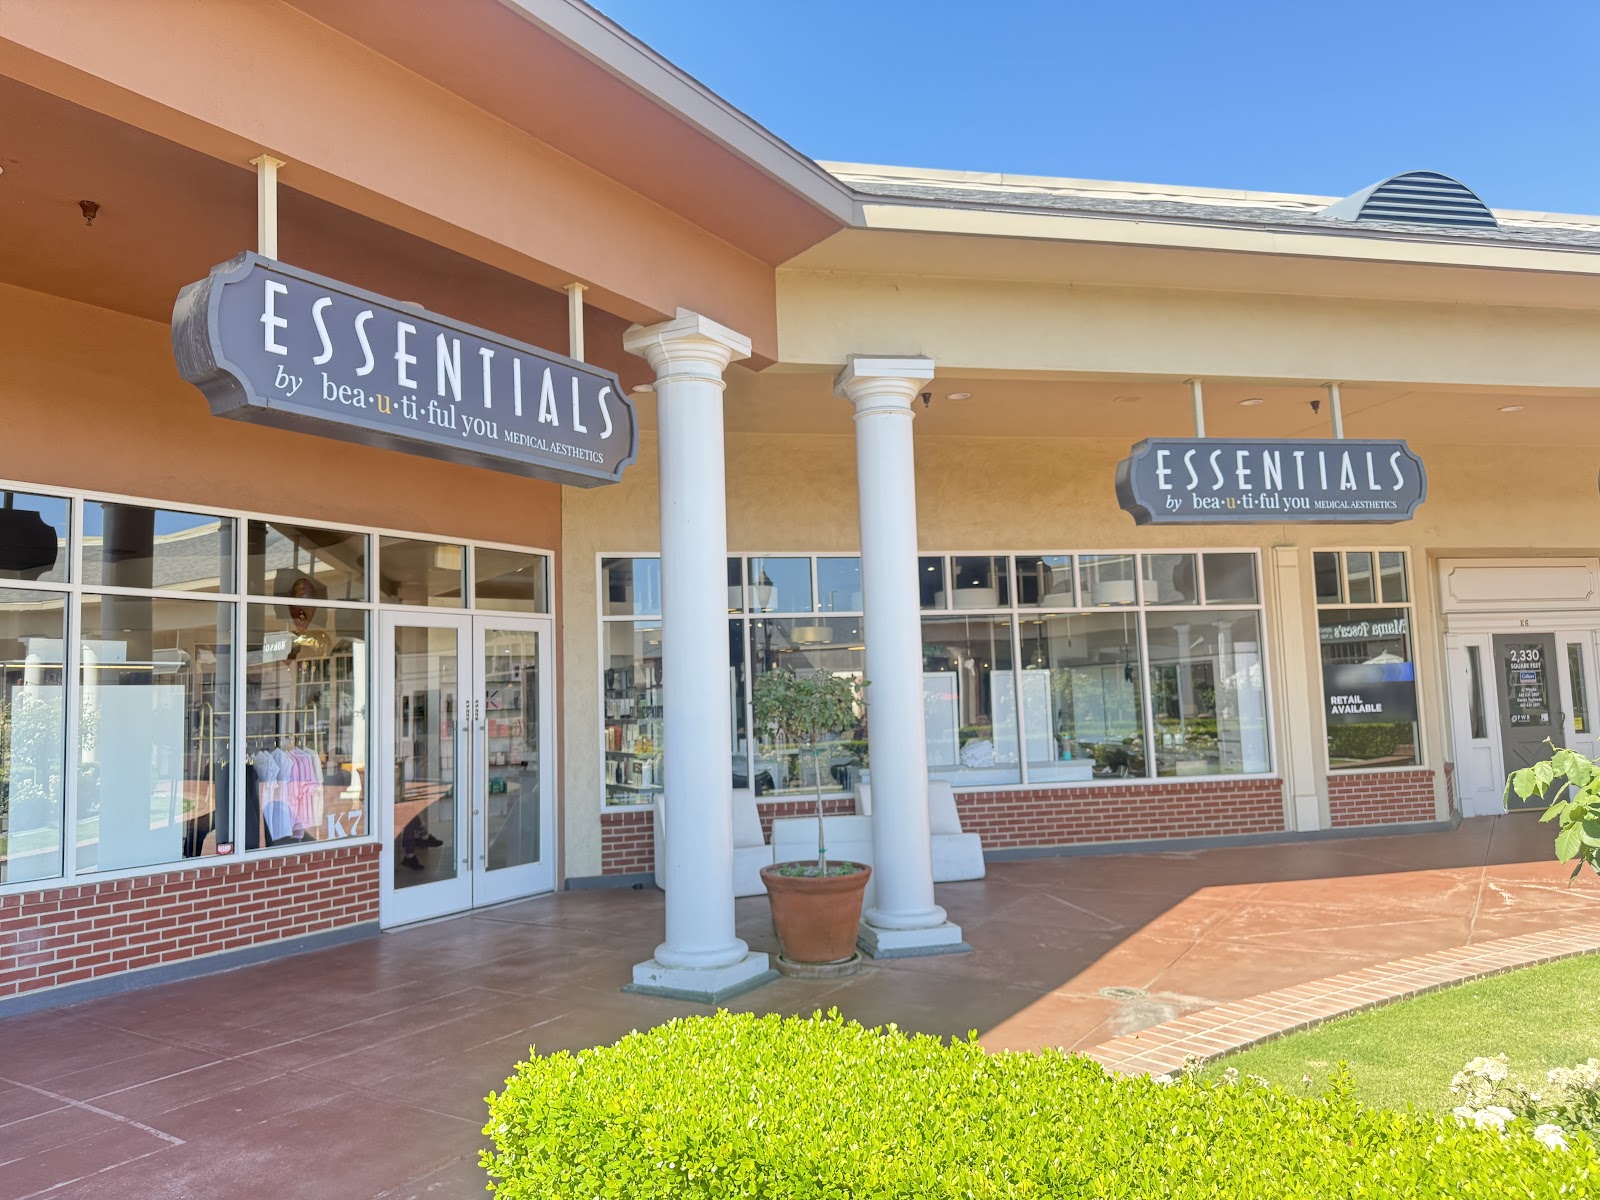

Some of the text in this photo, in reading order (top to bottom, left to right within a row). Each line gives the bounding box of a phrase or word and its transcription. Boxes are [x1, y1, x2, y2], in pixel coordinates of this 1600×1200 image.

[260, 279, 613, 440] ESSENTIALS
[274, 365, 303, 397] by
[461, 414, 499, 439] you
[504, 430, 549, 451] MEDICAL
[550, 442, 604, 464] AESTHETICS
[1156, 449, 1404, 491] ESSENTIALS
[1165, 495, 1182, 512] by
[1283, 497, 1310, 512] you
[1314, 500, 1350, 509] MEDICAL
[1351, 500, 1398, 509] AESTHETICS
[1510, 650, 1539, 663] 2,330
[1330, 695, 1363, 705] RETAIL
[1331, 703, 1383, 714] AVAILABLE
[327, 810, 362, 840] K7
